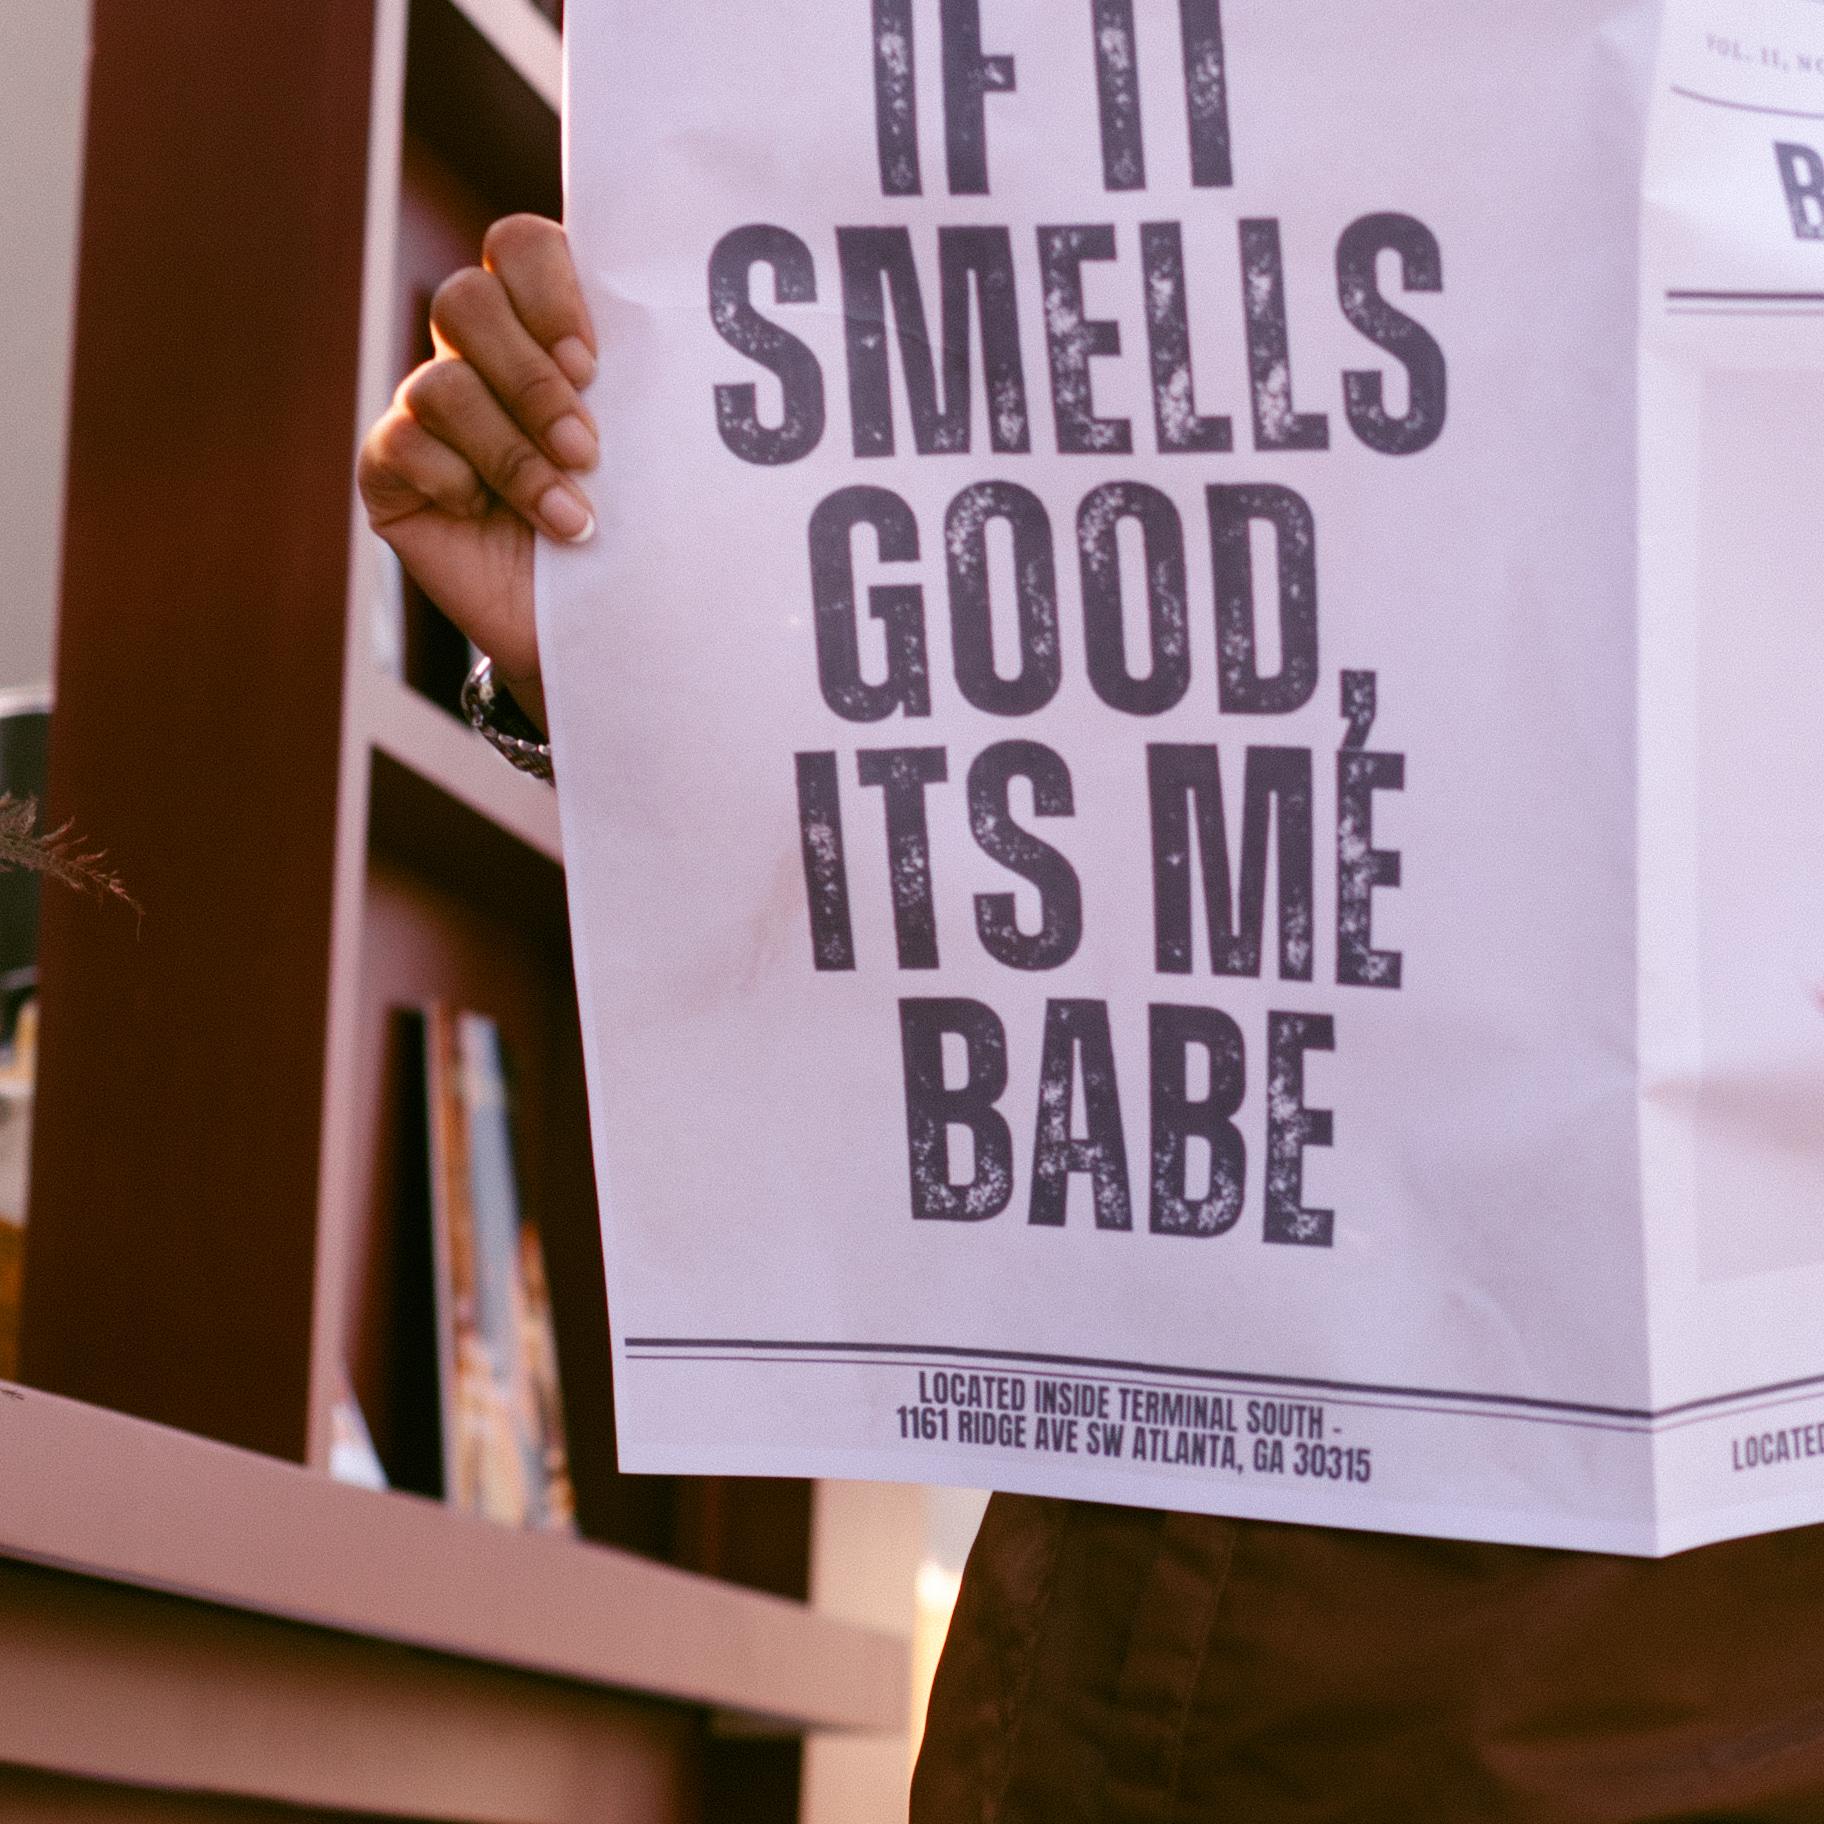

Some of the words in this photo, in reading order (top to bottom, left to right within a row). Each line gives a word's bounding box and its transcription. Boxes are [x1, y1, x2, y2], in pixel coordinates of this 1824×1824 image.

[707, 211, 1447, 466] SMELLS
[808, 480, 1377, 747] GOOD,
[795, 739, 1083, 973] ITS
[1146, 743, 1405, 990] ME
[898, 996, 1336, 1248] BABE
[897, 1406, 950, 1441] 1161
[957, 1410, 1027, 1449] RIDGE
[1035, 1416, 1079, 1454] AVE
[1086, 1422, 1125, 1458] SW
[1132, 1427, 1245, 1475] ATLANTA,
[1253, 1439, 1285, 1475] GA
[1292, 1443, 1372, 1483] 30315
[918, 1370, 1027, 1411] LOCATED
[1034, 1379, 1109, 1420] INSIDE
[1118, 1387, 1237, 1433] TERMINAL
[1246, 1400, 1324, 1439] SOUTH
